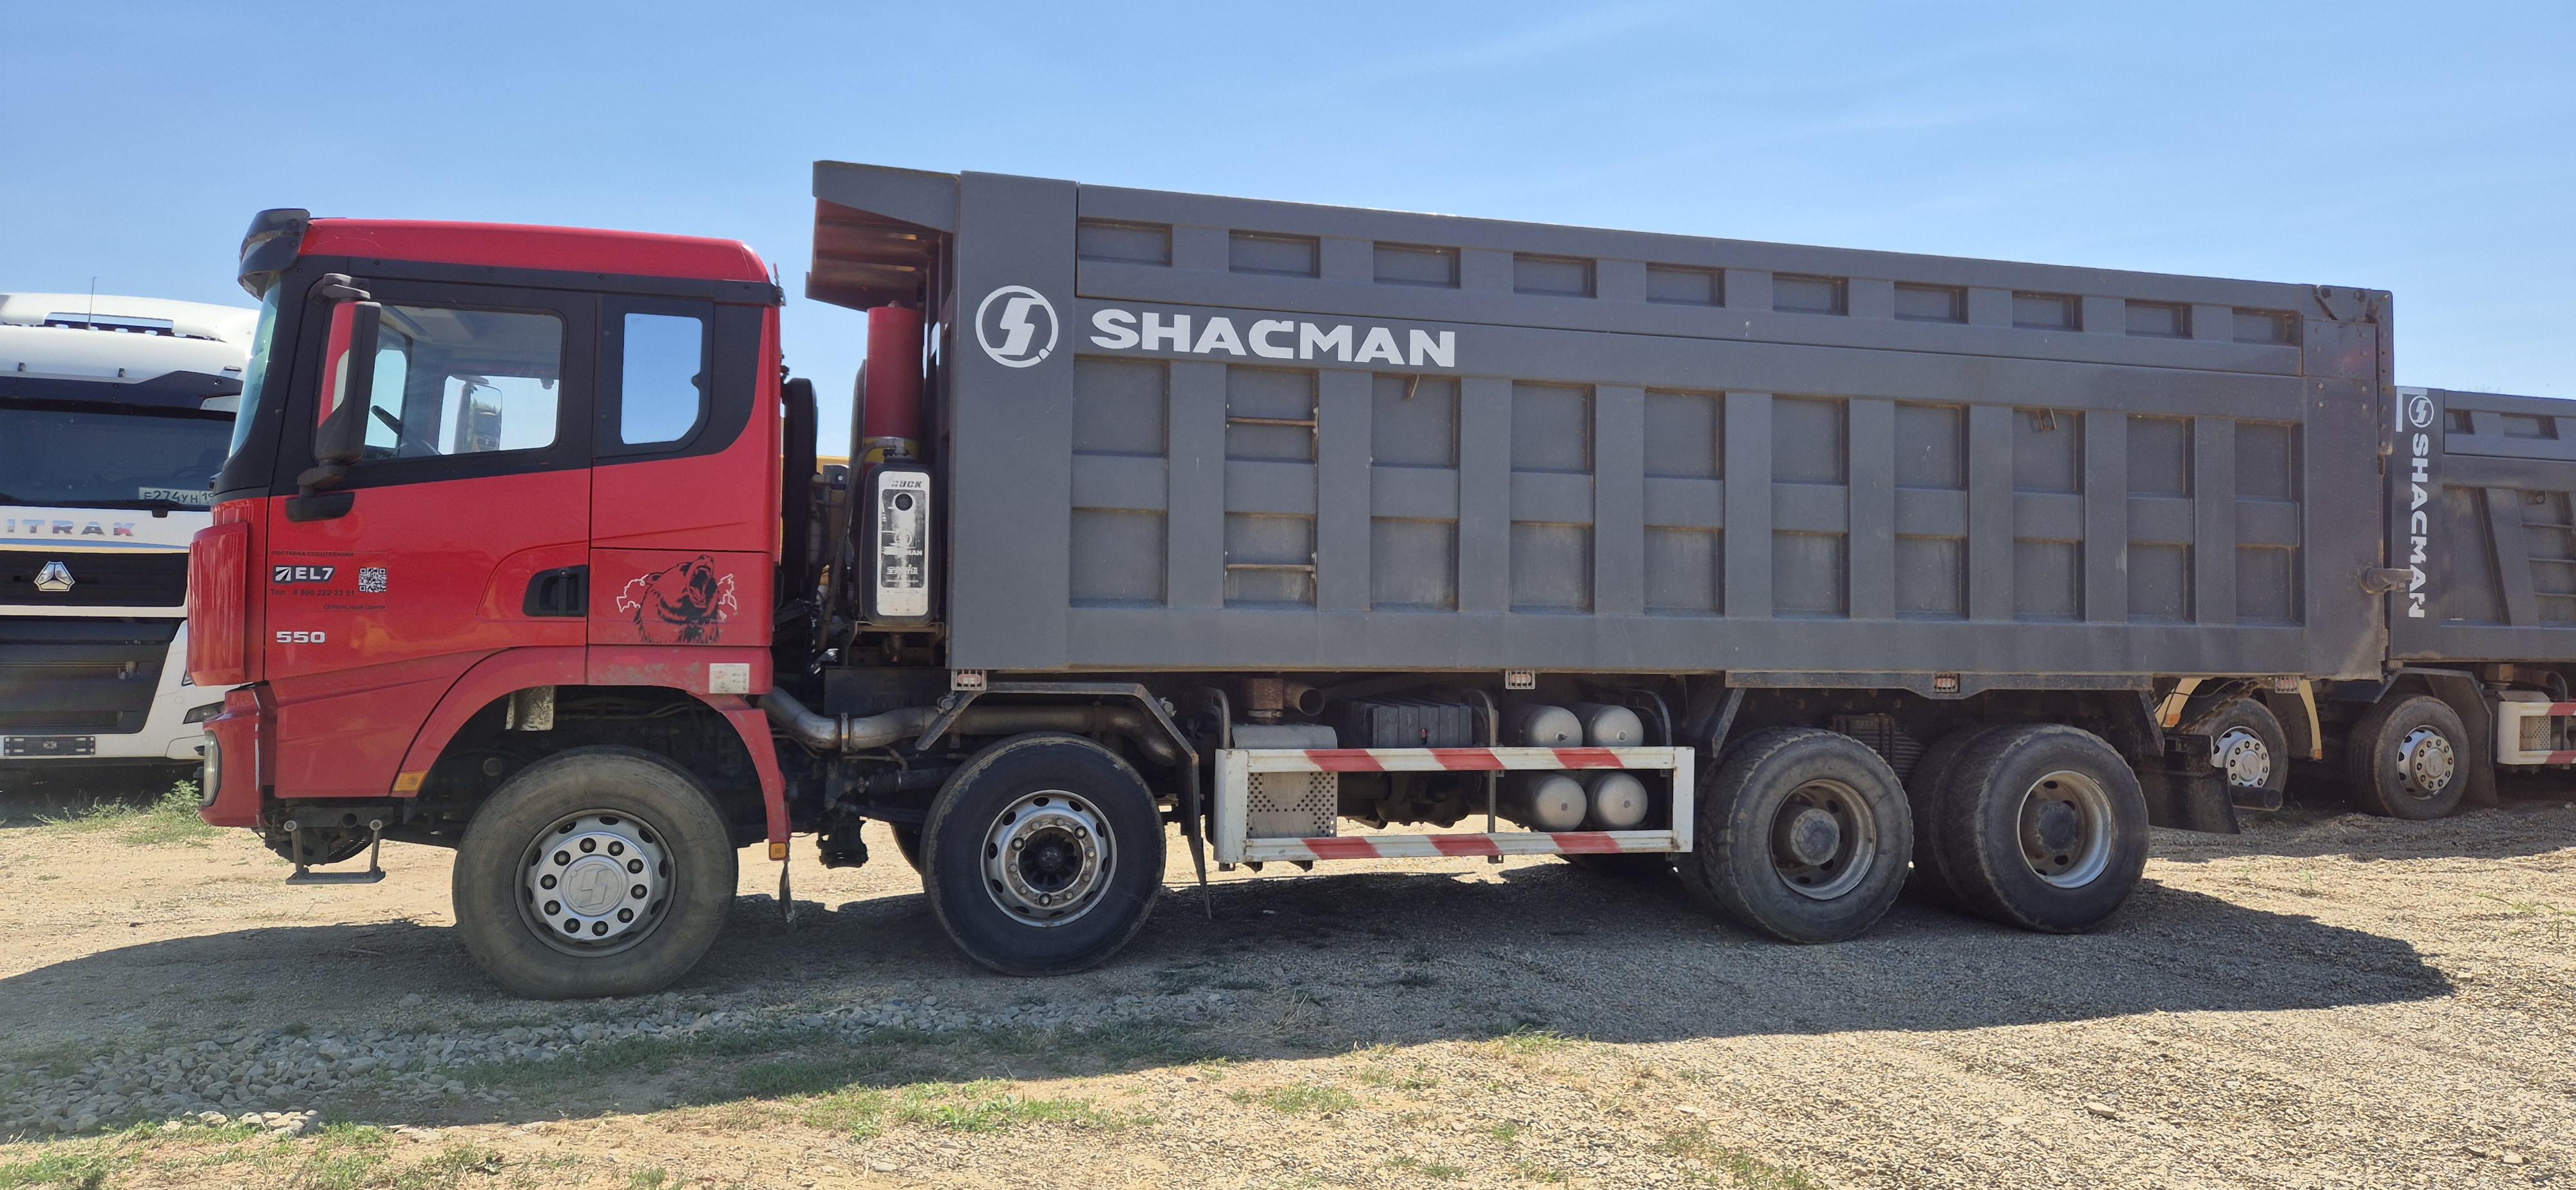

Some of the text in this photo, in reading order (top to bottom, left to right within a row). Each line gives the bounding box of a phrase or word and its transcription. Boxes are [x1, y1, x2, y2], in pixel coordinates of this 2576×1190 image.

[1090, 308, 1455, 368] SHACMAN
[7, 518, 136, 536] ITRAK
[2409, 433, 2429, 618] SHACMAN
[295, 567, 334, 580] EL7
[276, 631, 326, 643] 550
